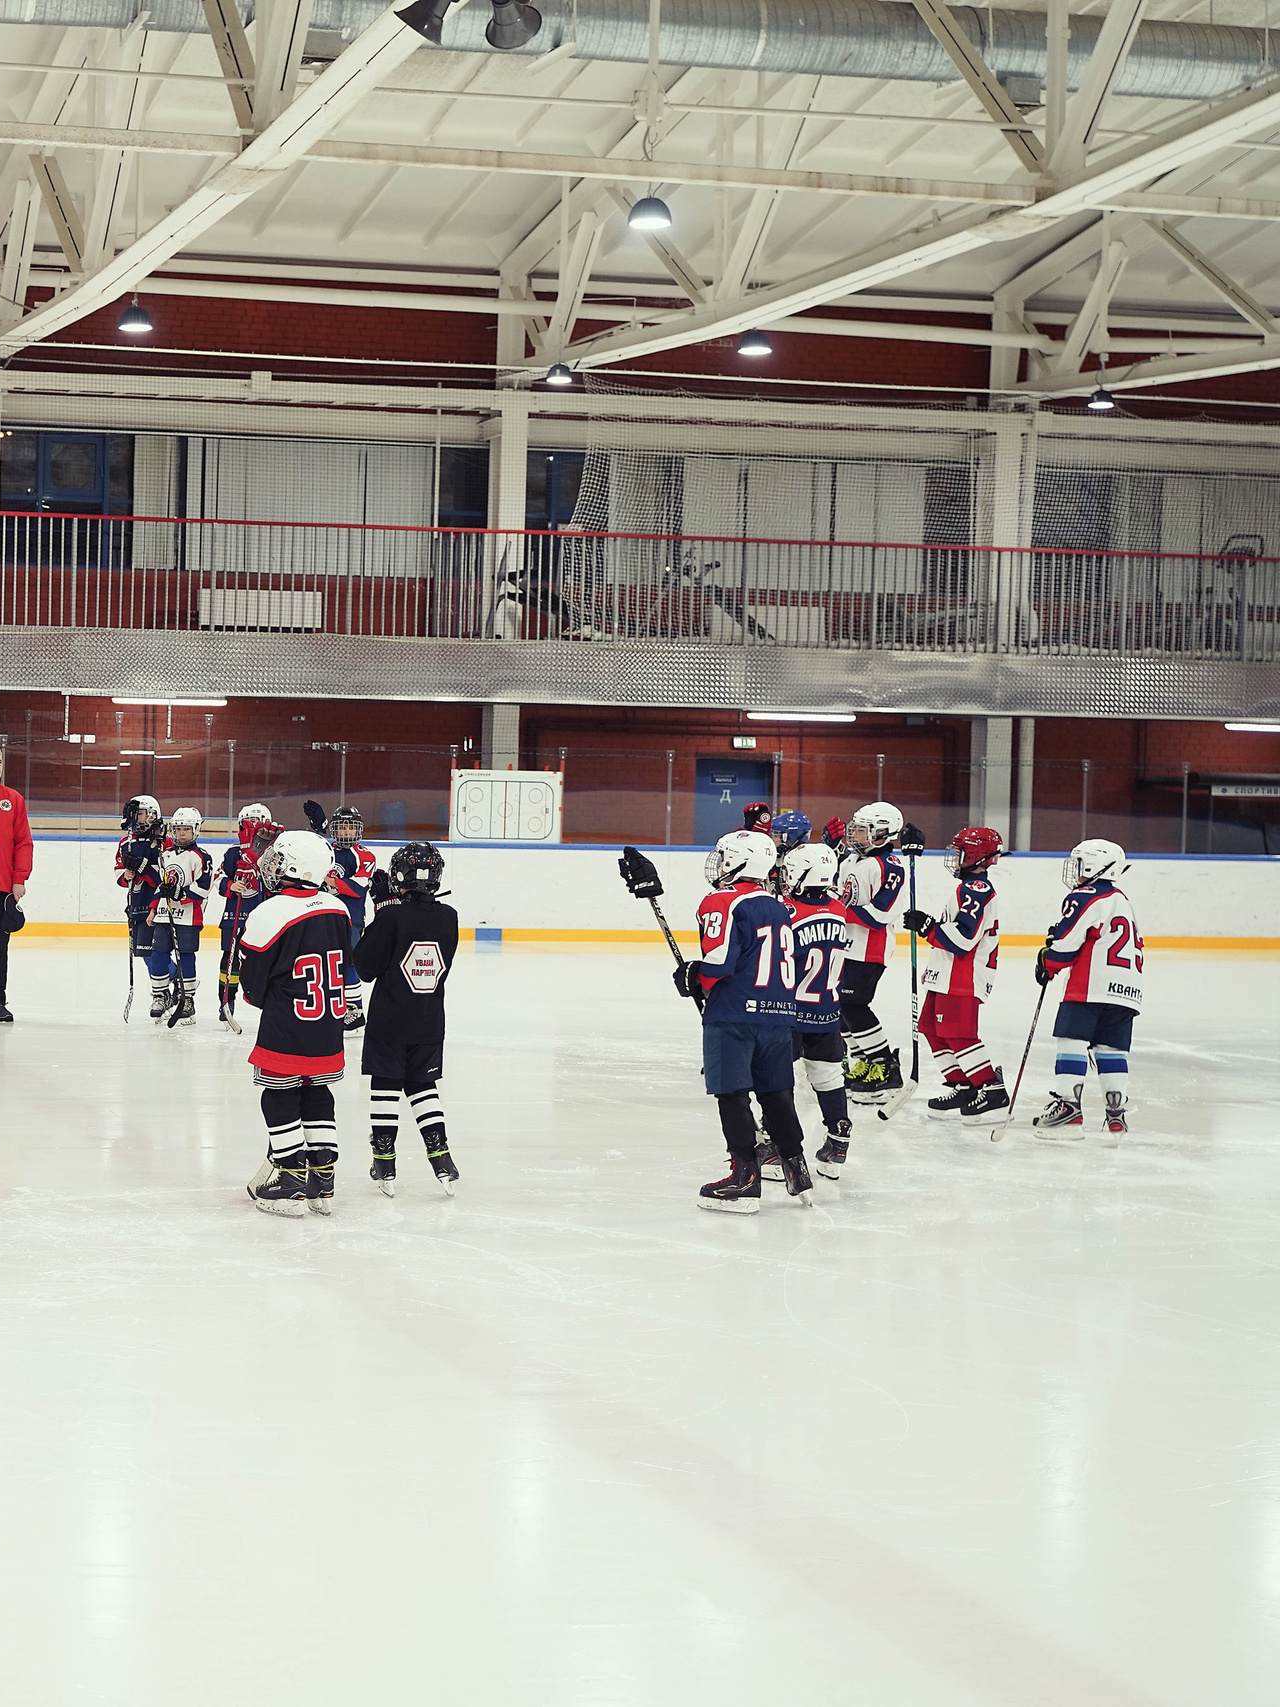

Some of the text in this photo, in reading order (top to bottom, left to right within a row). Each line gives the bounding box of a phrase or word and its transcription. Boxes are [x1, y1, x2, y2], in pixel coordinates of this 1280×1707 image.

[720, 789, 732, 804] Д
[959, 894, 981, 920] 22
[754, 924, 796, 991] 73
[1106, 916, 1145, 975] 25
[292, 949, 348, 1022] 35
[1107, 982, 1142, 1000] КВАНТ-
